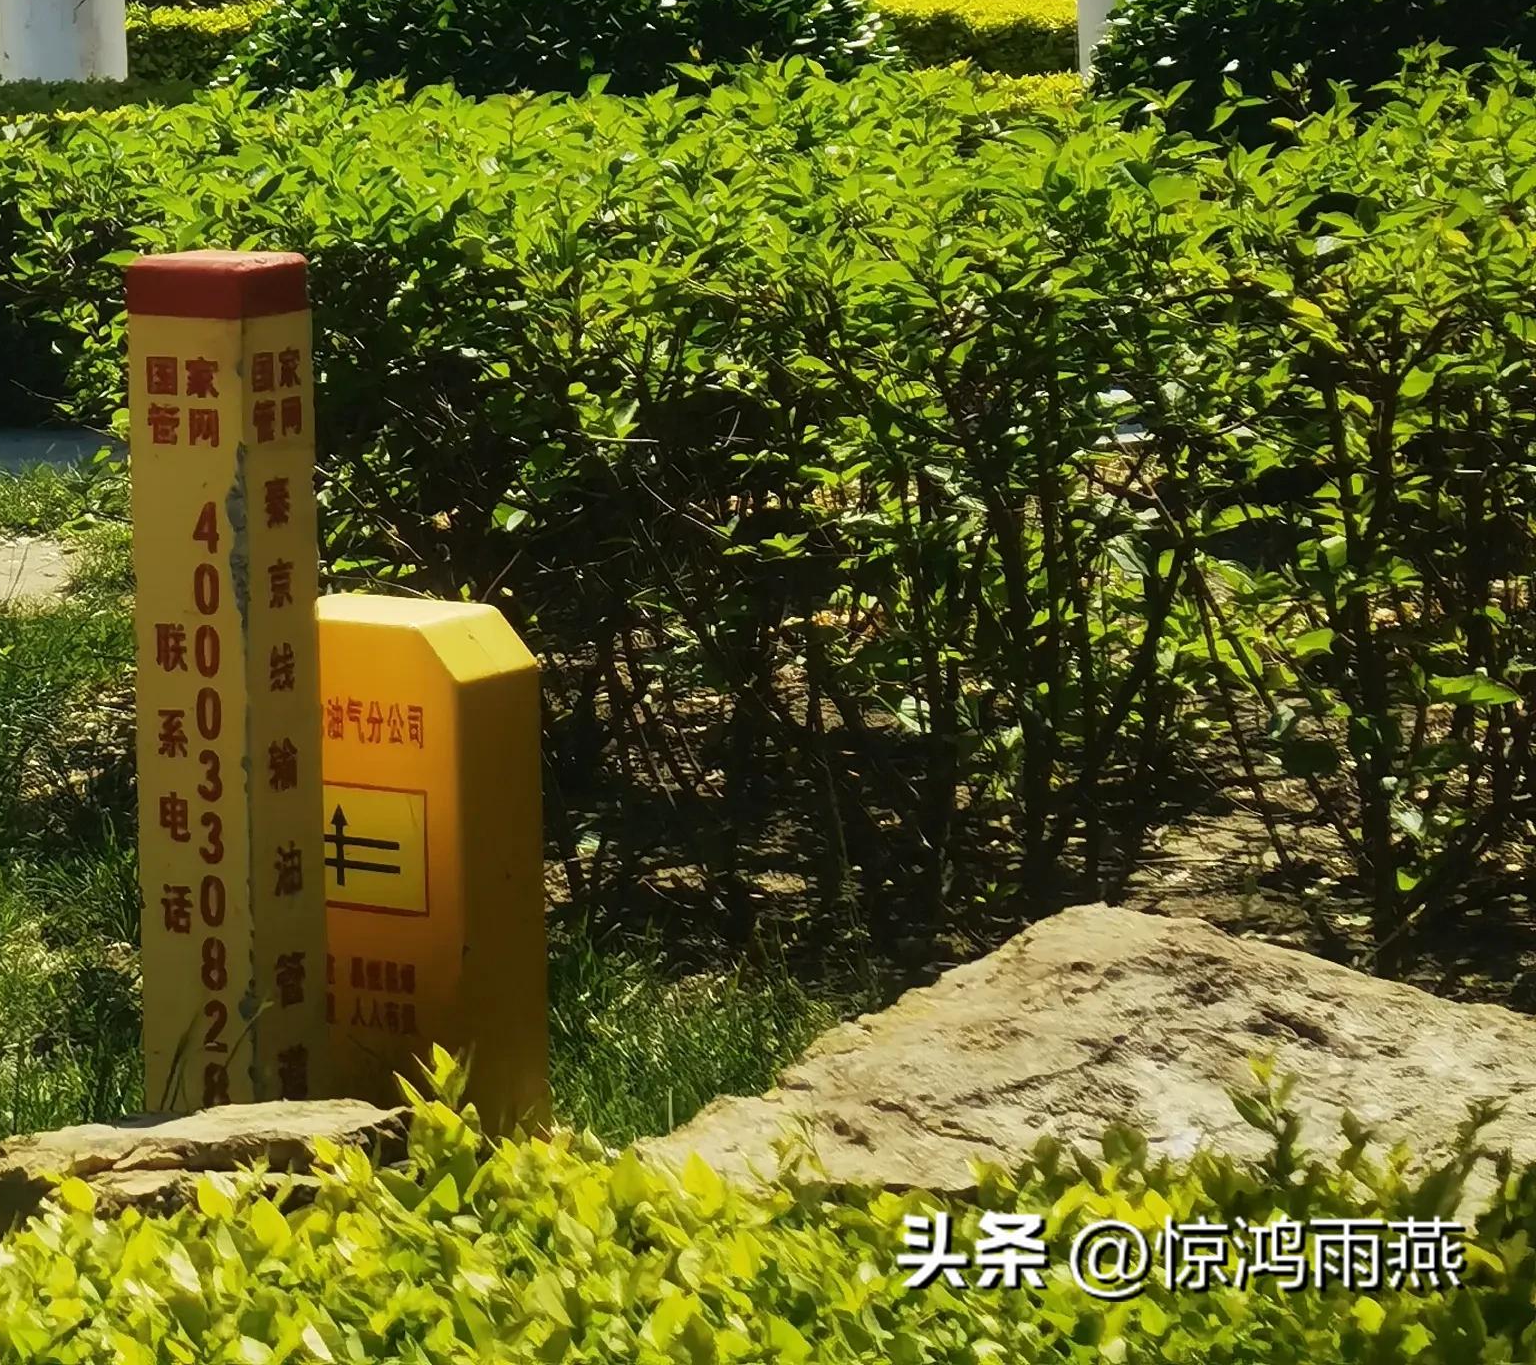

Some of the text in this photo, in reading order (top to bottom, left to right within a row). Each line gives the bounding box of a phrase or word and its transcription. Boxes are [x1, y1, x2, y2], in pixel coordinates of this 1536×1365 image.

[155, 623, 193, 934] 联系电话
[321, 696, 424, 750] 油气分公司
